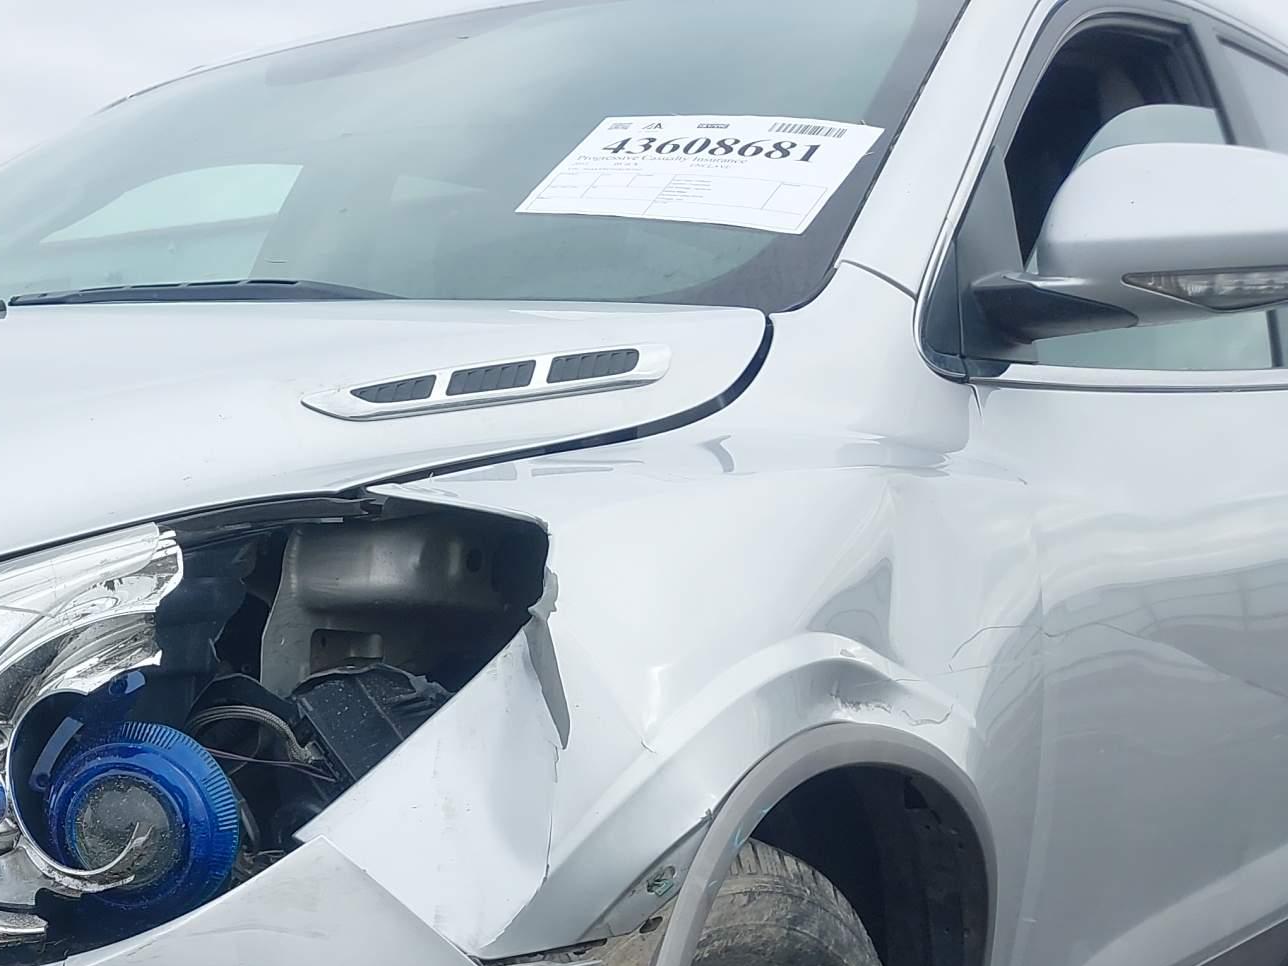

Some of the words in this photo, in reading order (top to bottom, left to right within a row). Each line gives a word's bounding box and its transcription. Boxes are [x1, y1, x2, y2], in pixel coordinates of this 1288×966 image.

[602, 136, 821, 163] 43608681
[577, 154, 640, 162] Progressive
[692, 156, 747, 165] Insurance
